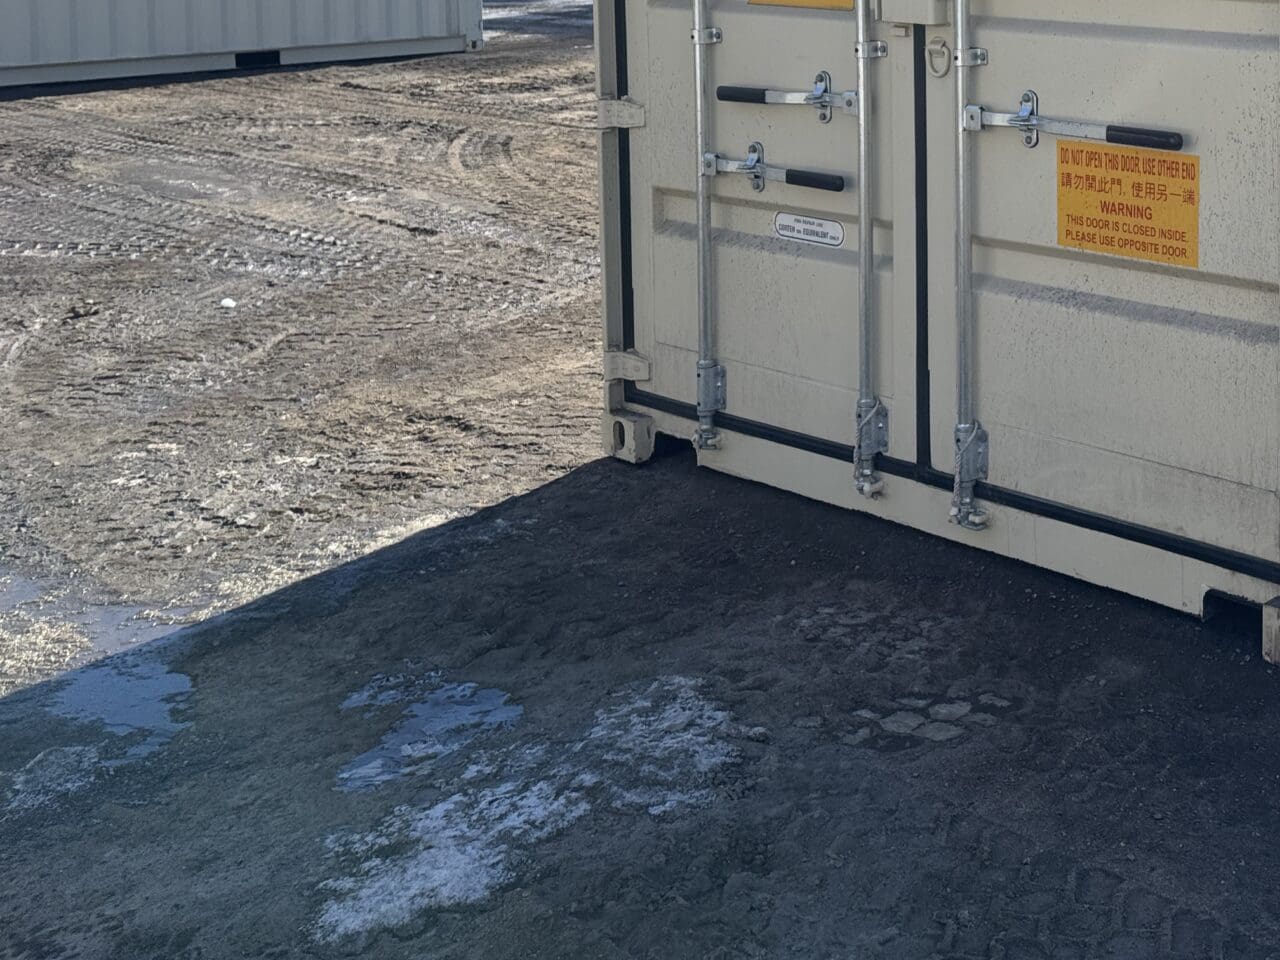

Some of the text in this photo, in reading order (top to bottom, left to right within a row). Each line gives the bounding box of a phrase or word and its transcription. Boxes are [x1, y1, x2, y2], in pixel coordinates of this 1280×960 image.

[1060, 147, 1070, 164] DO
[1071, 149, 1084, 165] NOT
[1086, 150, 1102, 168] OPEN
[1104, 152, 1119, 171] THIS
[1143, 157, 1157, 175] USE
[1158, 159, 1180, 178] OTHER
[1181, 162, 1196, 181] END
[1100, 200, 1153, 220] WARNING
[1066, 214, 1084, 226] THIS
[1086, 217, 1110, 231] DOOR
[1112, 221, 1120, 231] IS
[1122, 222, 1156, 238] CLOSED
[1065, 230, 1097, 244] PLEASE
[1099, 234, 1115, 247] USE
[1117, 237, 1159, 254] OPPOSITE
